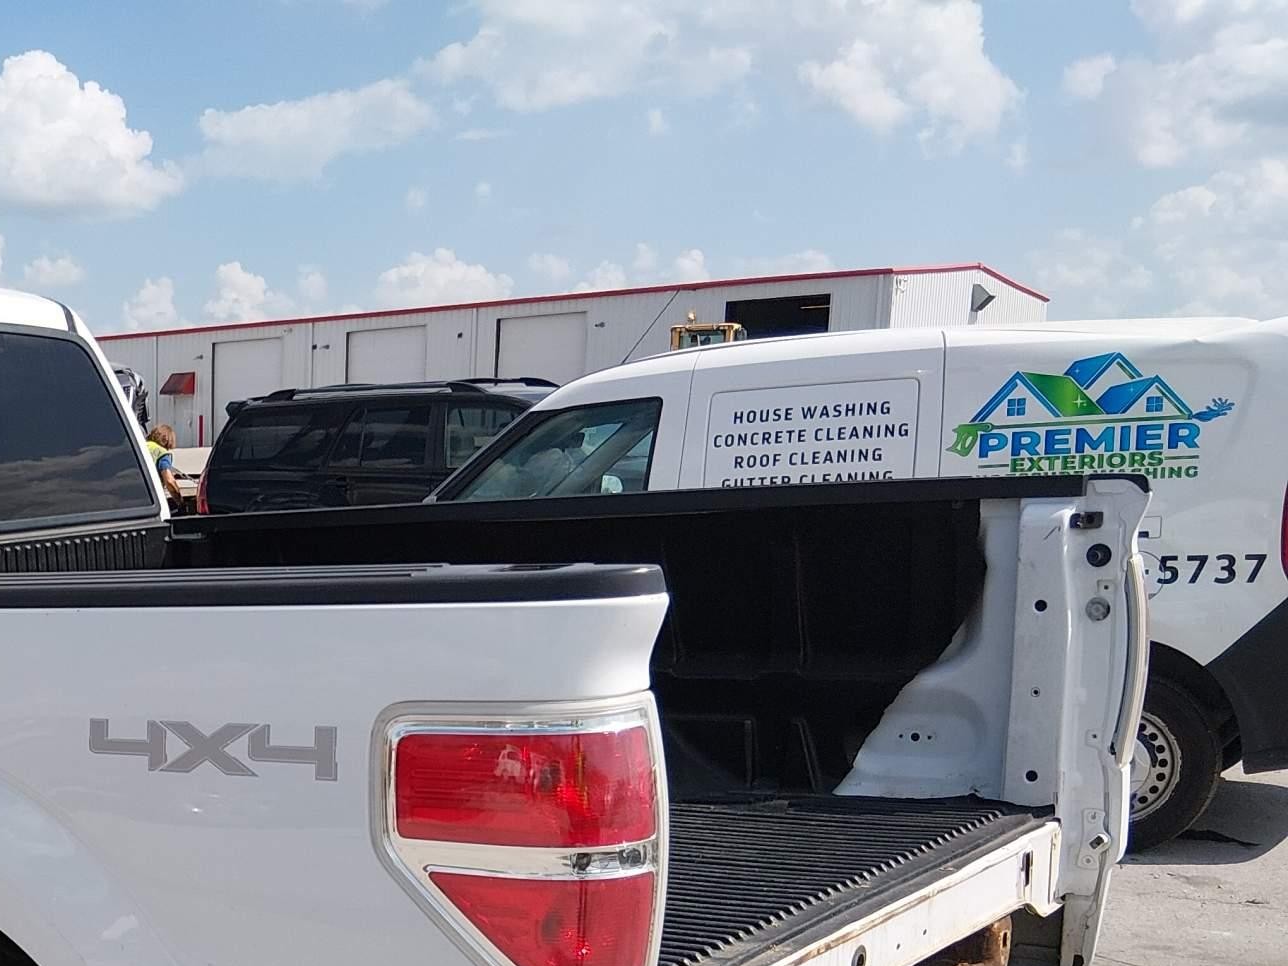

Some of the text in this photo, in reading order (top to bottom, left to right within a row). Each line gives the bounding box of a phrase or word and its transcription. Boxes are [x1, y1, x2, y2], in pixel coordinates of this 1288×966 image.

[733, 401, 892, 424] HOUSE WASHING
[713, 423, 909, 448] CONCRETE CLEANING
[978, 422, 1201, 458] PREMIER
[734, 448, 883, 469] ROOF CLEANING
[1010, 451, 1164, 473] EXTERIORS
